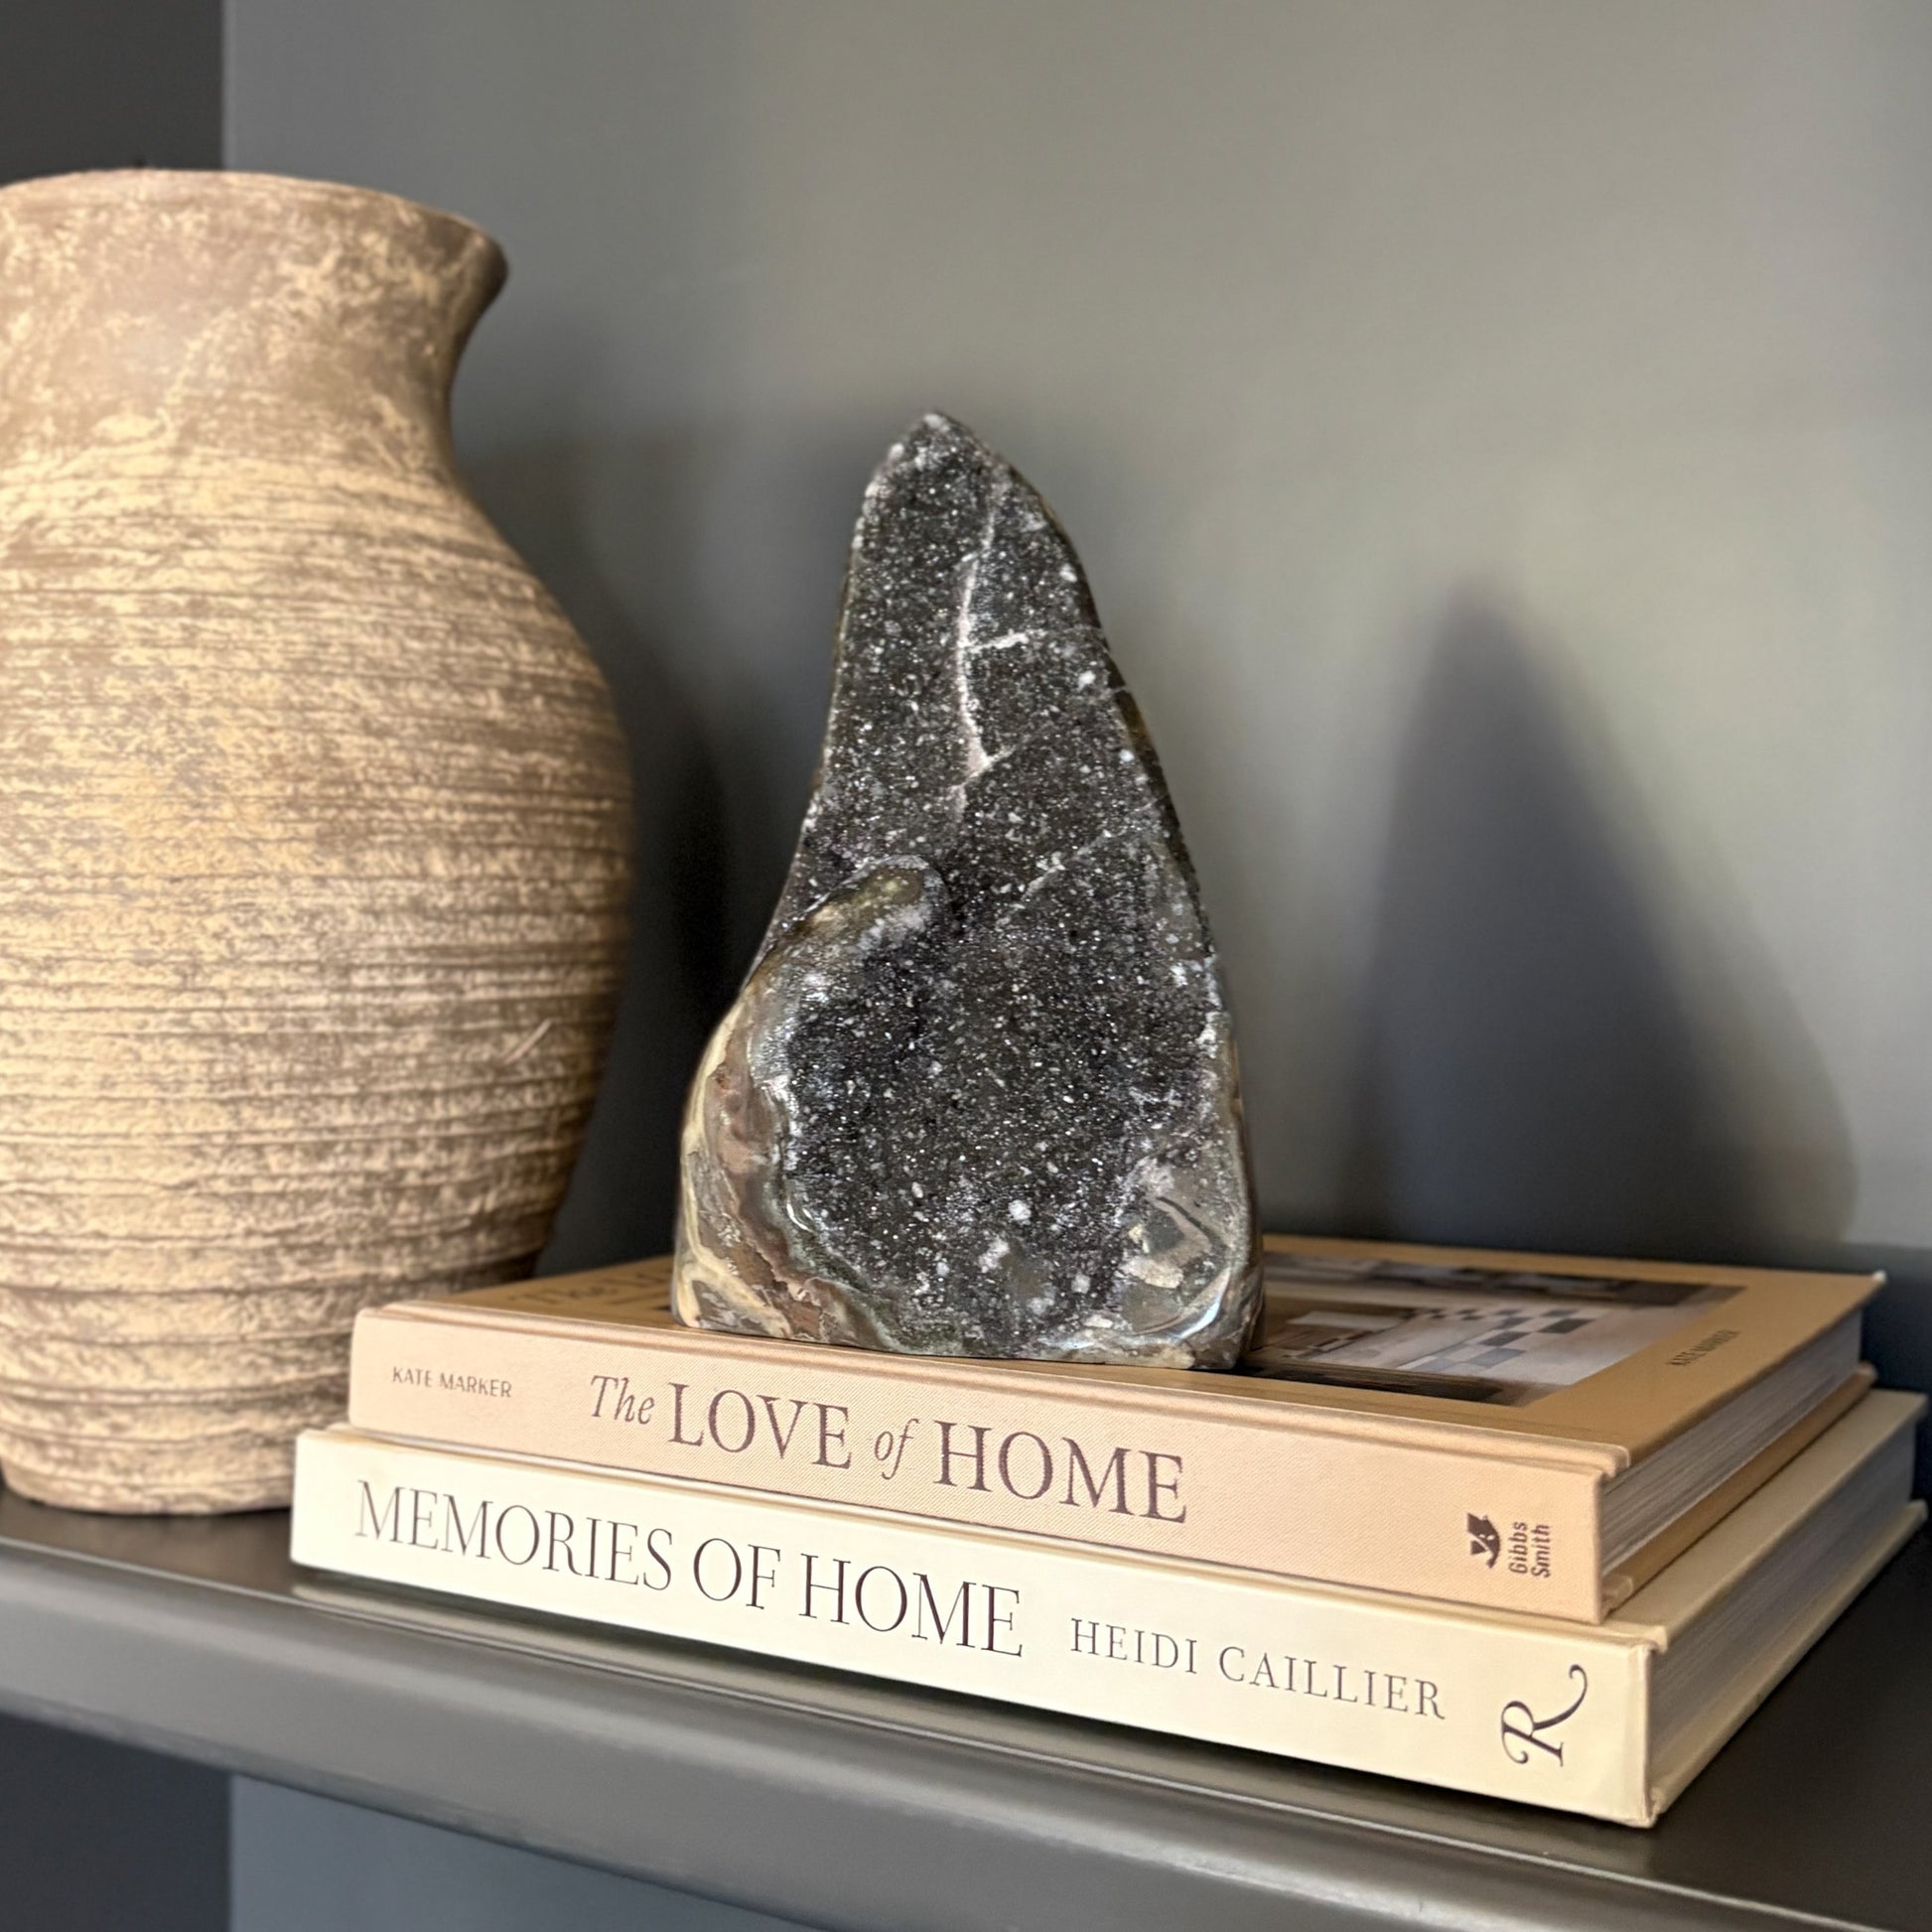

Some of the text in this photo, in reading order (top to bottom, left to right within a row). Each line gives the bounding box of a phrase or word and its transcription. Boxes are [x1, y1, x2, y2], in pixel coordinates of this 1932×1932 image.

[392, 1366, 512, 1399] KATE MARKER
[591, 1375, 1187, 1524] The LOVE of HOME
[354, 1480, 1023, 1658] MEMORIES OF HOME
[1508, 1521, 1528, 1574] Gibbs
[1530, 1524, 1551, 1578] Smith
[1070, 1617, 1446, 1720] HEIDI CAILLIER
[1500, 1663, 1587, 1767] R
